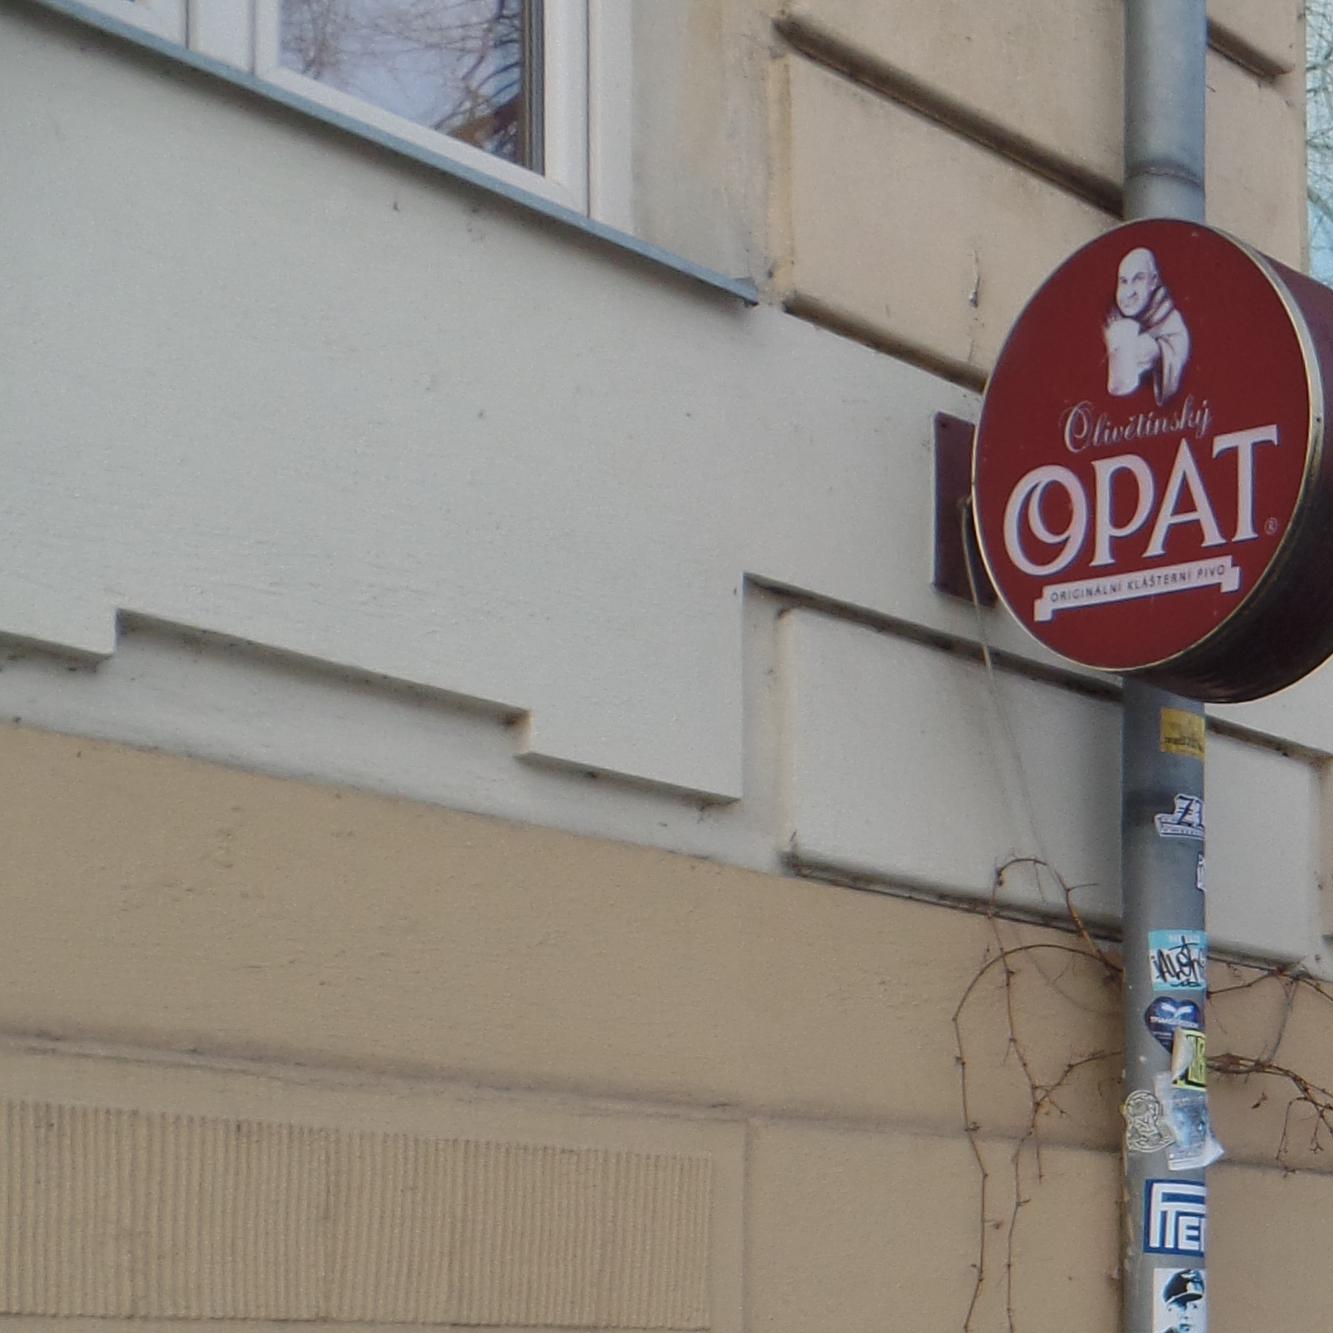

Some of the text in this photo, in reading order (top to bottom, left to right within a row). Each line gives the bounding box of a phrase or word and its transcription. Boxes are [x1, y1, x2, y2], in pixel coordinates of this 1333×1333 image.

[1003, 425, 1278, 577] OPAT
[1126, 571, 1192, 592] KLÁŠTERNÍ
[1196, 564, 1226, 580] PIVO
